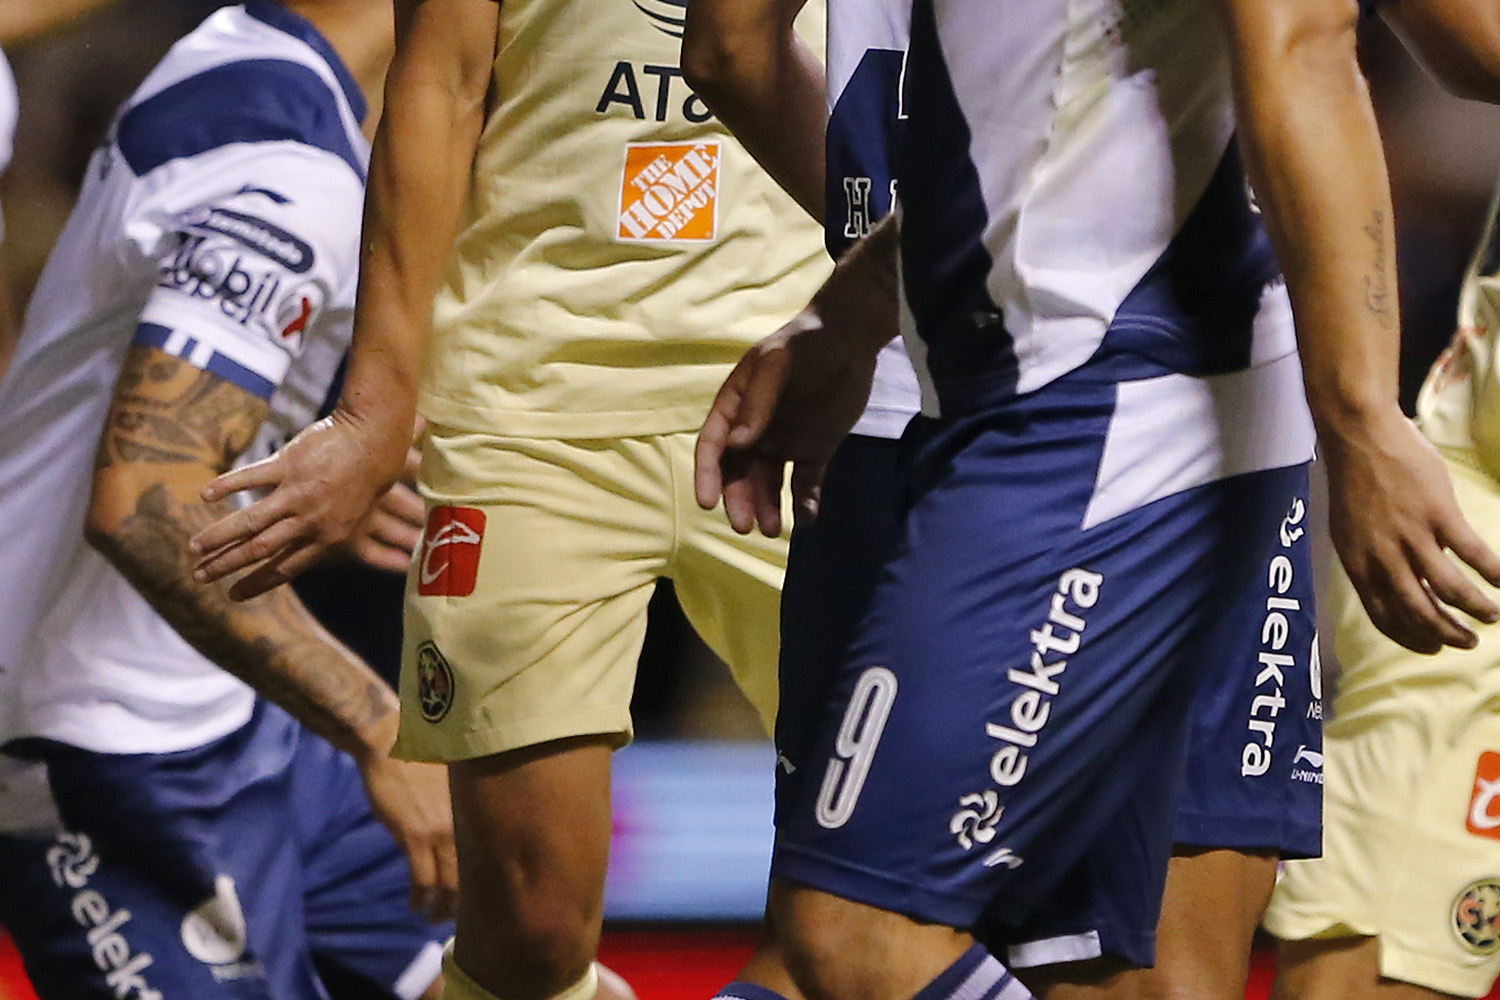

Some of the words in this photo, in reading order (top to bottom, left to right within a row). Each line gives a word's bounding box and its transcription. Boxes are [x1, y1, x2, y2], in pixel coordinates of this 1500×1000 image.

[619, 142, 720, 239] HOME
[630, 153, 673, 192] THE
[655, 178, 717, 240] DEPOT
[986, 566, 1103, 787] elektra
[1241, 554, 1300, 778] elektra
[816, 666, 898, 829] 9
[71, 889, 164, 1000] elek
